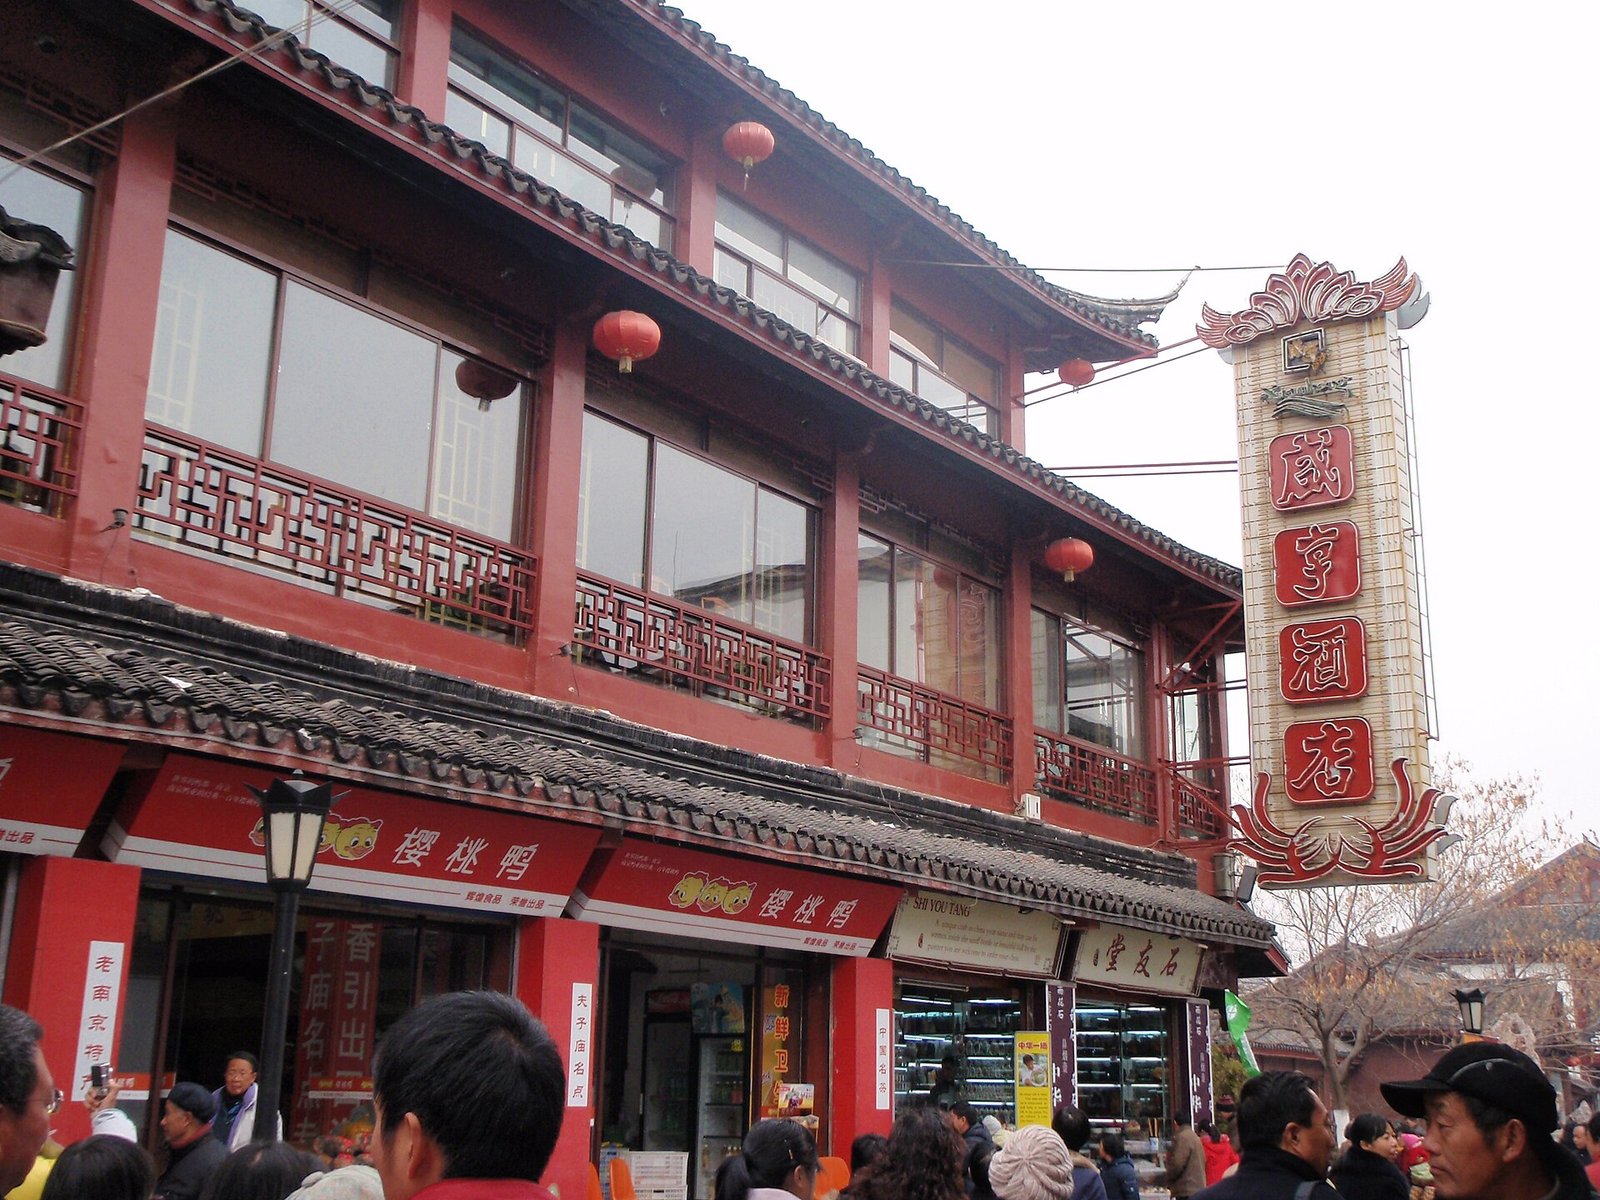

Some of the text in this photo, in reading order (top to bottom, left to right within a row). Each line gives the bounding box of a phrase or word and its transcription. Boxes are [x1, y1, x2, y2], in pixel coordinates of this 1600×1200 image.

[1276, 428, 1356, 798] 咸亨酒店
[392, 827, 539, 881] 樱桃鸭
[509, 896, 545, 910] 荣誉出品
[759, 888, 859, 929] 樱桃鸭
[912, 896, 972, 918] SHI YOU TANG
